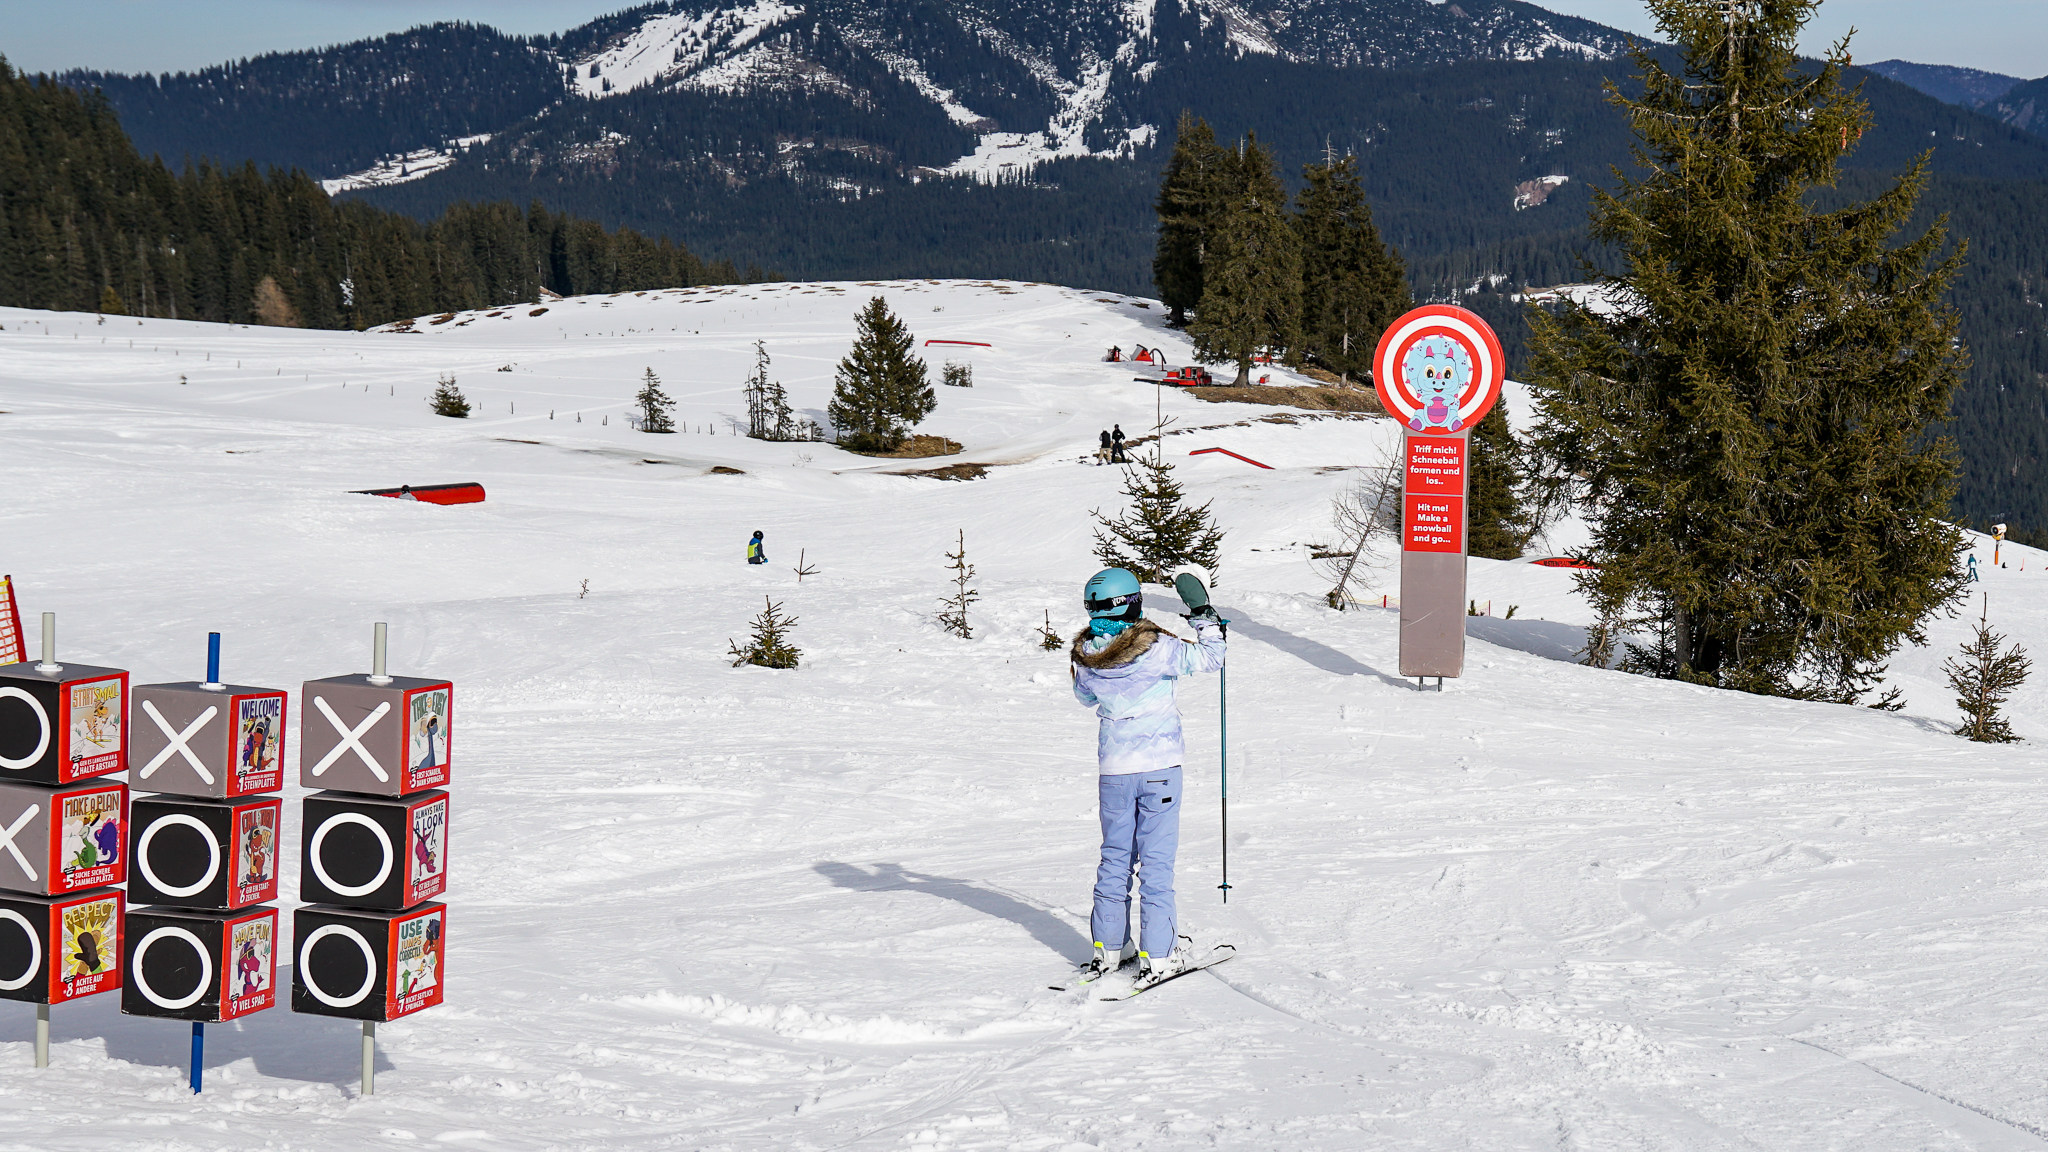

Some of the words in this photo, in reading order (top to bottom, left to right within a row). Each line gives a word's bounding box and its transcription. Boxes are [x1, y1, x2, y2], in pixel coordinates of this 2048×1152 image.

[1414, 445, 1432, 453] Triff
[1433, 446, 1457, 454] mich!
[1412, 455, 1459, 465] Schneeball
[1410, 465, 1441, 475] formen
[1443, 467, 1460, 475] und
[1426, 476, 1444, 485] los..
[1417, 504, 1431, 512] Hit
[1432, 504, 1449, 512] me!
[1417, 514, 1441, 522] Make
[1413, 524, 1452, 533] snowball
[1413, 534, 1430, 542] and
[1431, 536, 1451, 544] go...
[73, 686, 95, 708] START
[94, 682, 119, 701] SMALL
[242, 699, 280, 720] WELCOME
[412, 693, 428, 722] TAKE
[432, 692, 447, 716] EASY
[80, 765, 95, 775] HALTE
[96, 760, 118, 771] ABSTAND
[244, 777, 275, 790] STEINPLATTE
[65, 797, 89, 818] MAKE
[90, 798, 96, 813] A
[97, 792, 119, 812] PLAN
[415, 806, 433, 820] ALWAYS
[434, 802, 444, 814] TAKE
[242, 811, 258, 835] CALL
[416, 821, 420, 833] A
[423, 812, 443, 830] LOOK
[75, 870, 90, 879] SUCHE
[91, 867, 110, 877] SICHERE
[63, 902, 116, 927] RESPECT
[401, 919, 422, 939] USE
[234, 925, 254, 948] HAVE
[401, 936, 422, 952] JUMPS
[76, 976, 93, 987] ACHTE
[93, 974, 104, 983] AUF
[75, 984, 97, 995] ANDERE
[239, 999, 251, 1011] VIEL
